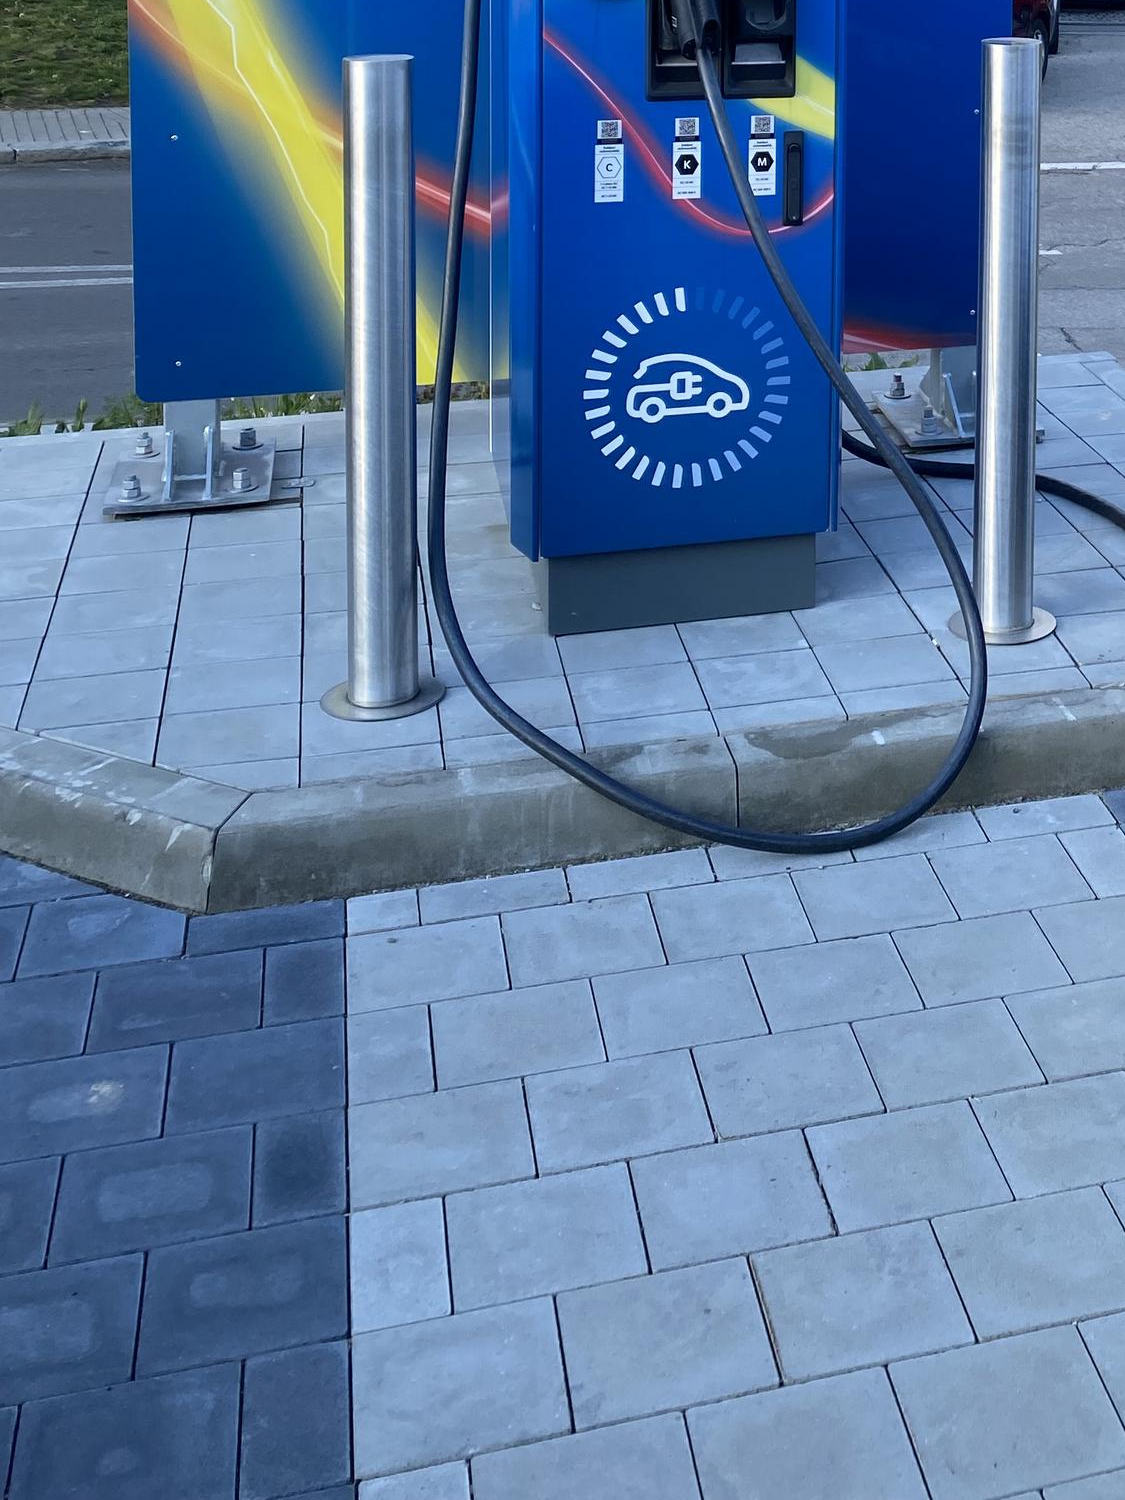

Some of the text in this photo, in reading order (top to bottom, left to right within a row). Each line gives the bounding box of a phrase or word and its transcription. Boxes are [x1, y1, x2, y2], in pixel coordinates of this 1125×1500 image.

[683, 160, 691, 169] K
[757, 157, 767, 166] M
[605, 163, 614, 172] C
